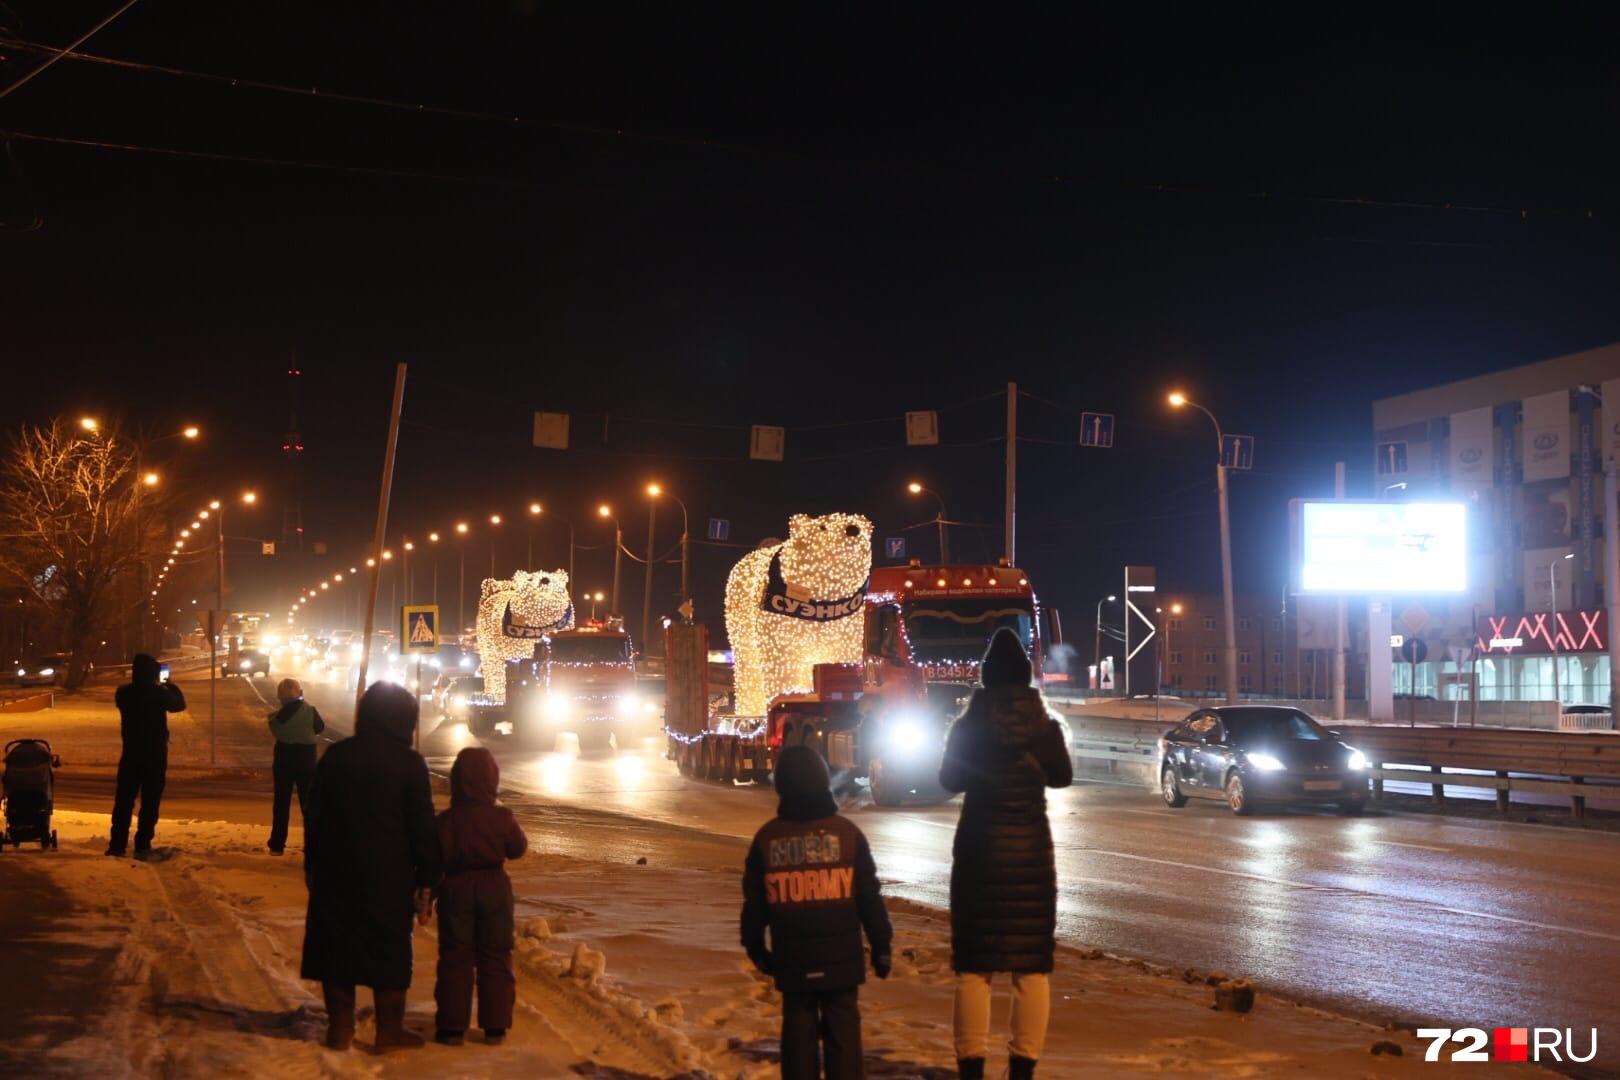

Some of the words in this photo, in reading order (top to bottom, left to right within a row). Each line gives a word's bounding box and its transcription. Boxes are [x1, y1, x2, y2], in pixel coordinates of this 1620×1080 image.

[771, 593, 863, 618] СУЭНКО
[507, 620, 567, 637] СУЭНО
[764, 867, 856, 904] STORMY
